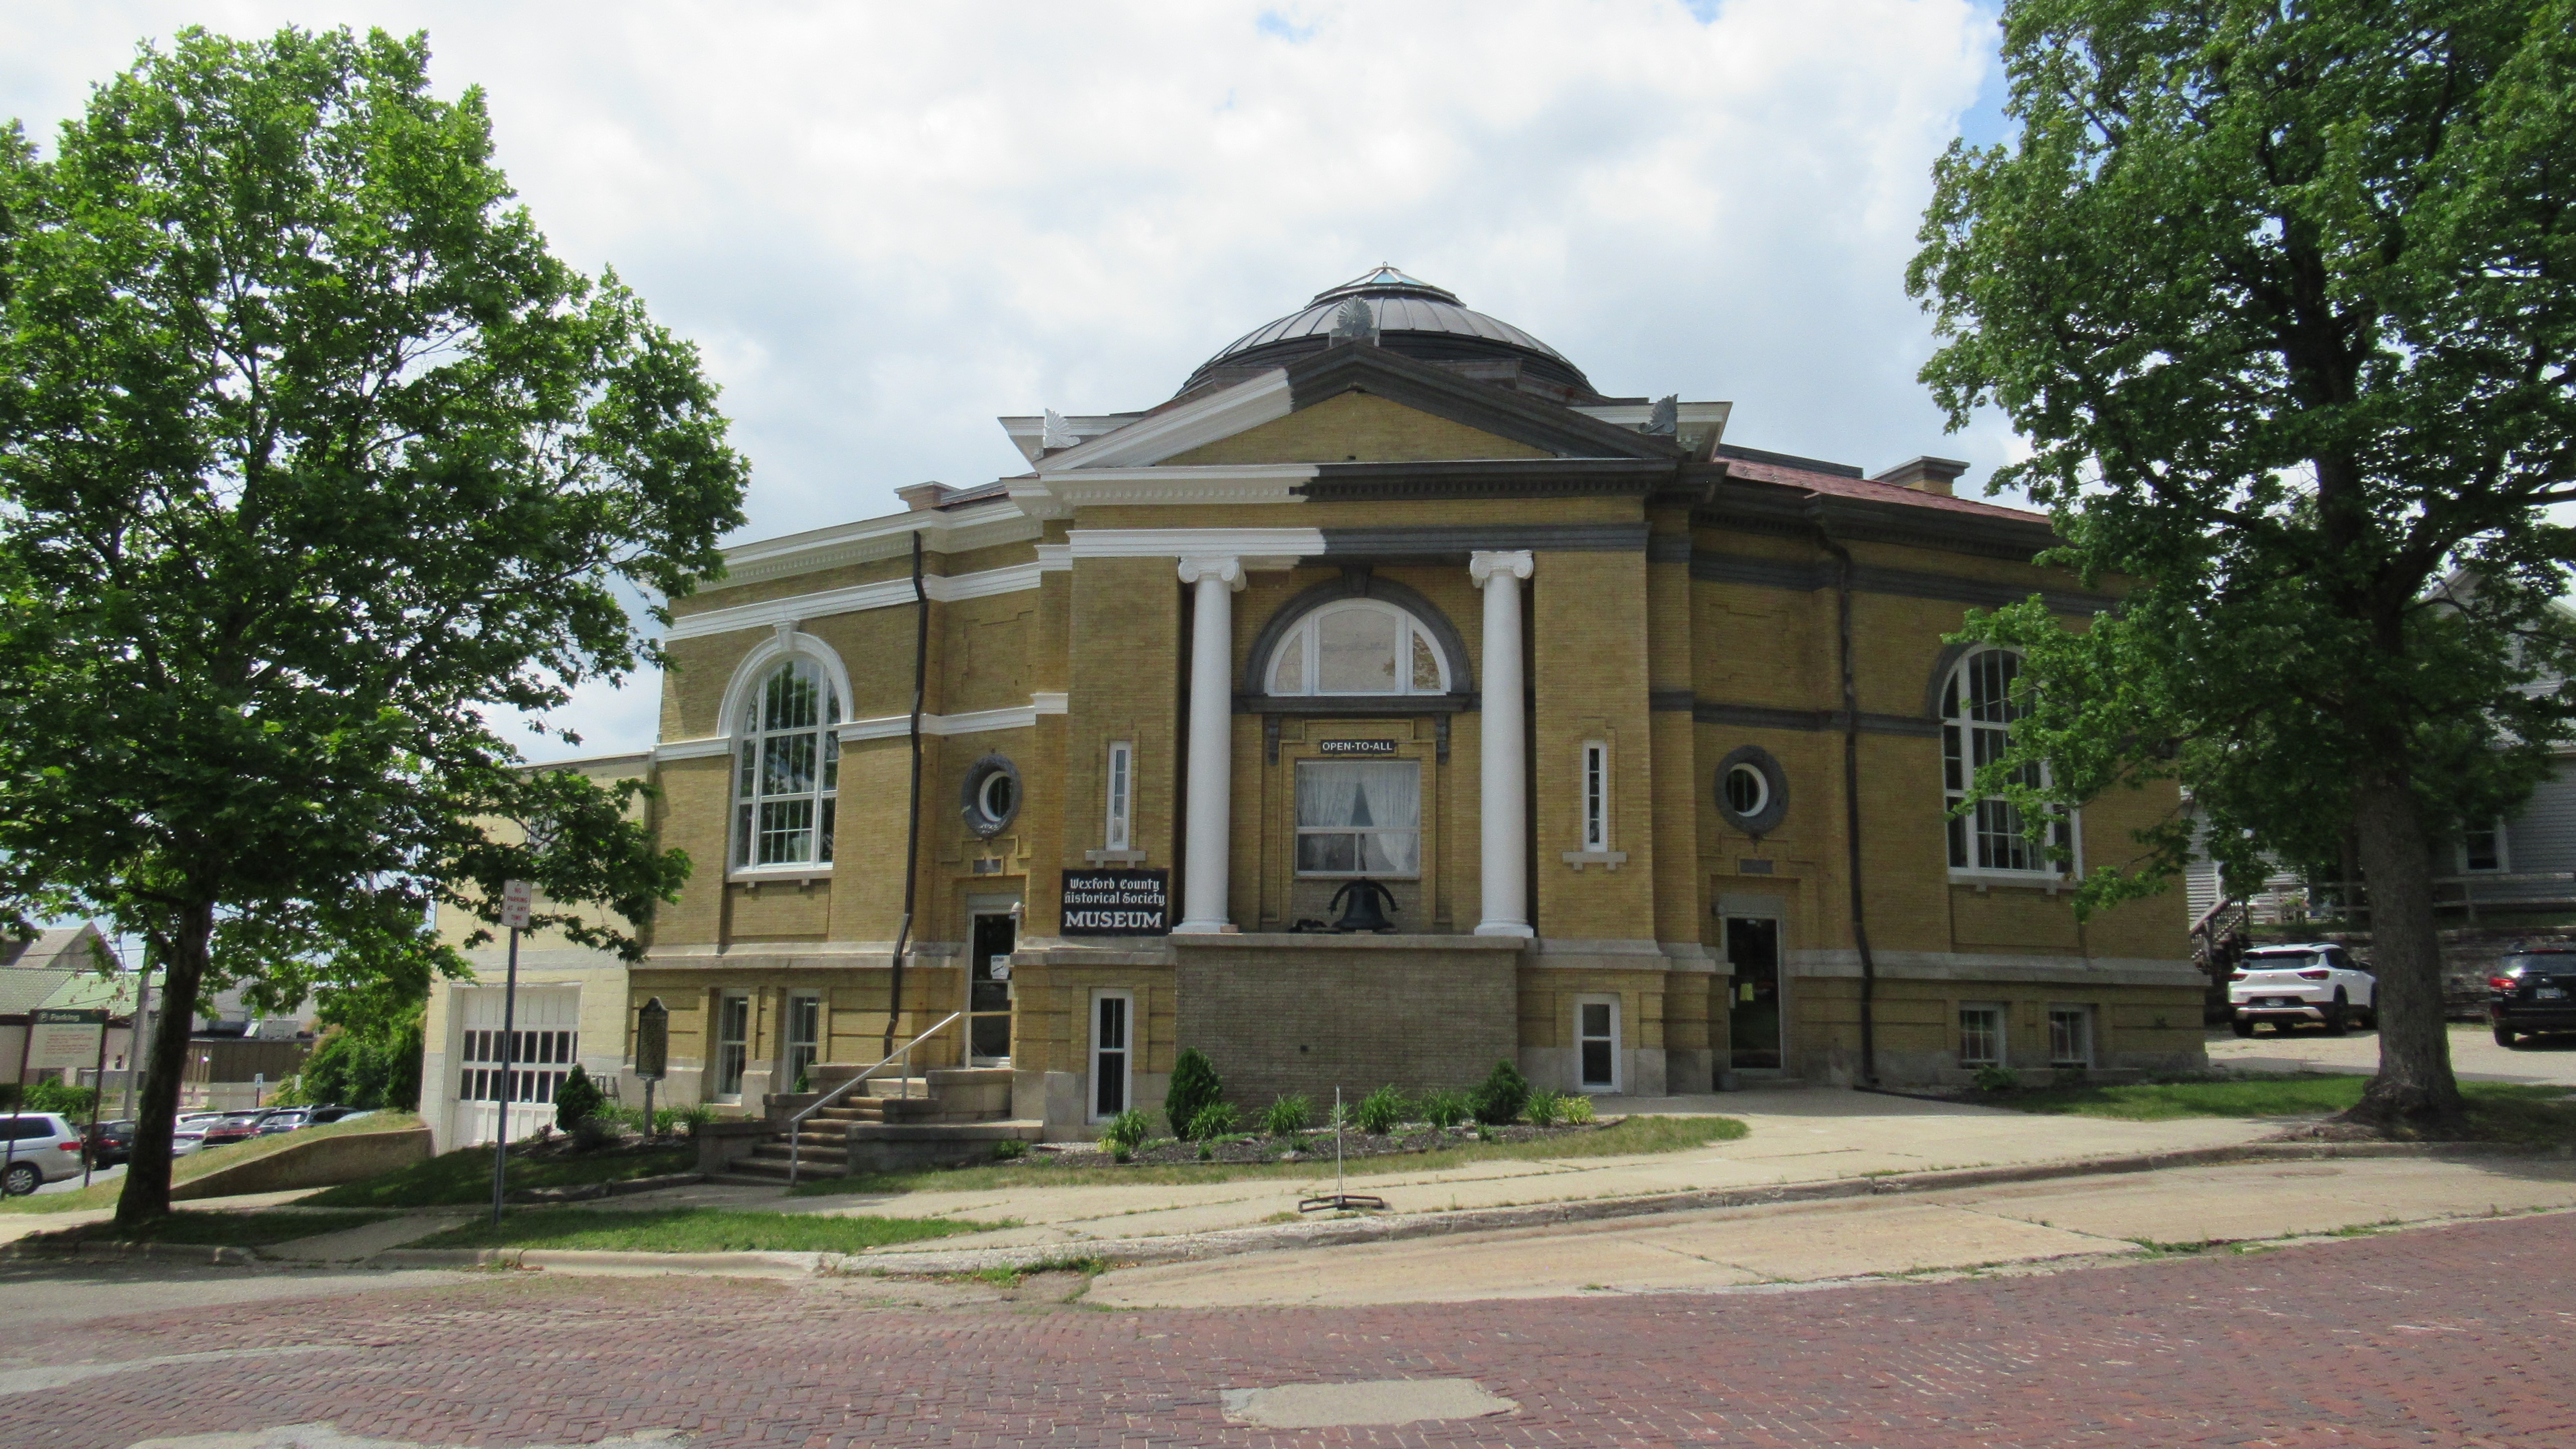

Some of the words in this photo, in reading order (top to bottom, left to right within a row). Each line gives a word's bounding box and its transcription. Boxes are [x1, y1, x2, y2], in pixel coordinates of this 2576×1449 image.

[1322, 742, 1393, 751] OPEN-TO-ALL
[1070, 877, 1115, 890] Wexford
[1120, 878, 1160, 893] County
[1064, 891, 1120, 904] Historical
[1122, 892, 1165, 906] Society
[1065, 911, 1162, 928] MUSEUM
